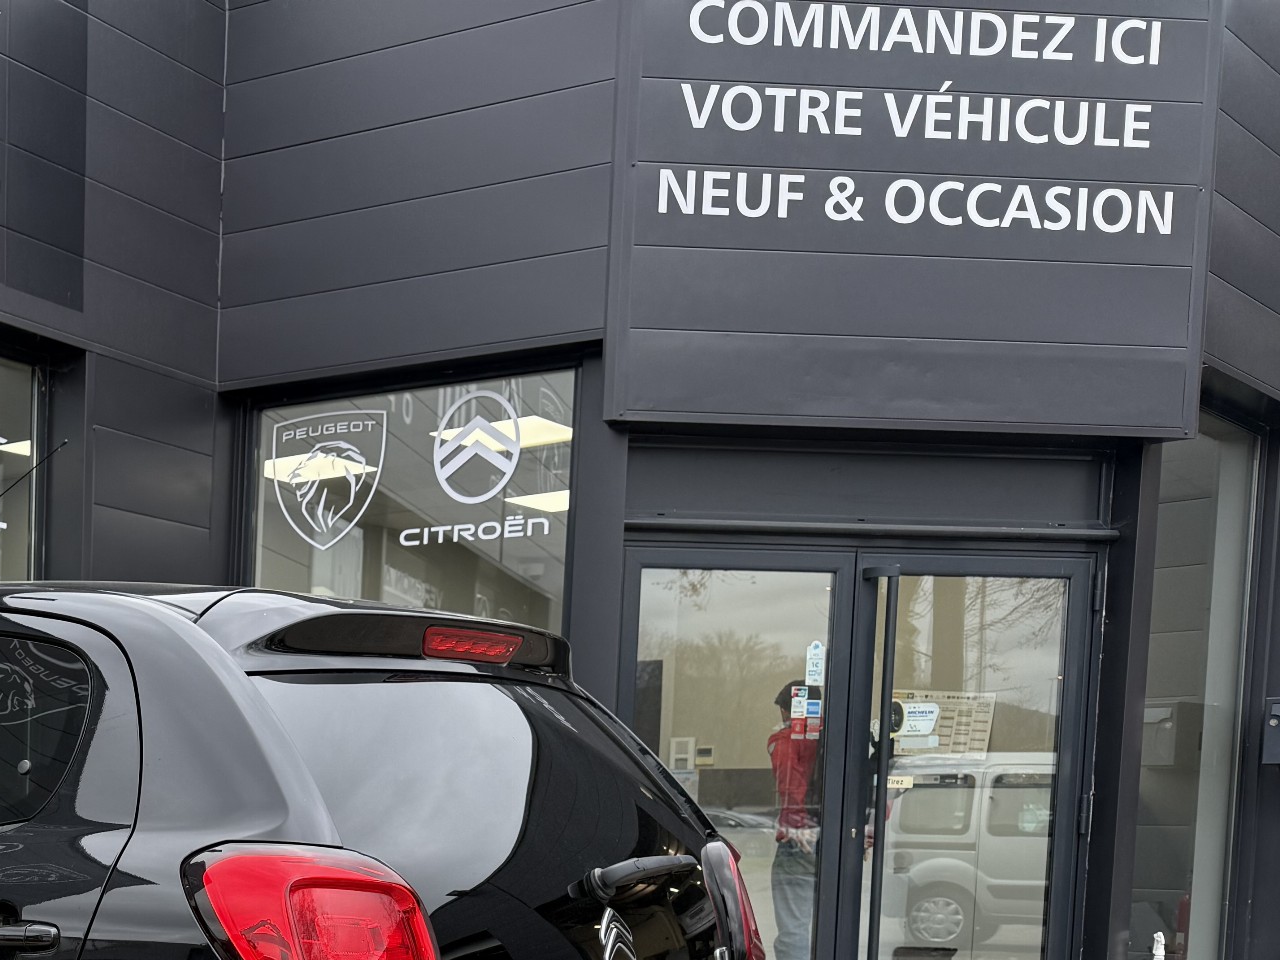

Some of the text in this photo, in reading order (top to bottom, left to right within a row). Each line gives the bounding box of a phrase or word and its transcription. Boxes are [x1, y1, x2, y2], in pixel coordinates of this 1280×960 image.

[689, 0, 1162, 65] COMMANDEZ ICI
[680, 80, 1152, 149] VOTRE VÉHICULE
[657, 168, 1174, 235] NEUF & OCCASION
[282, 420, 377, 443] PEUGEOT
